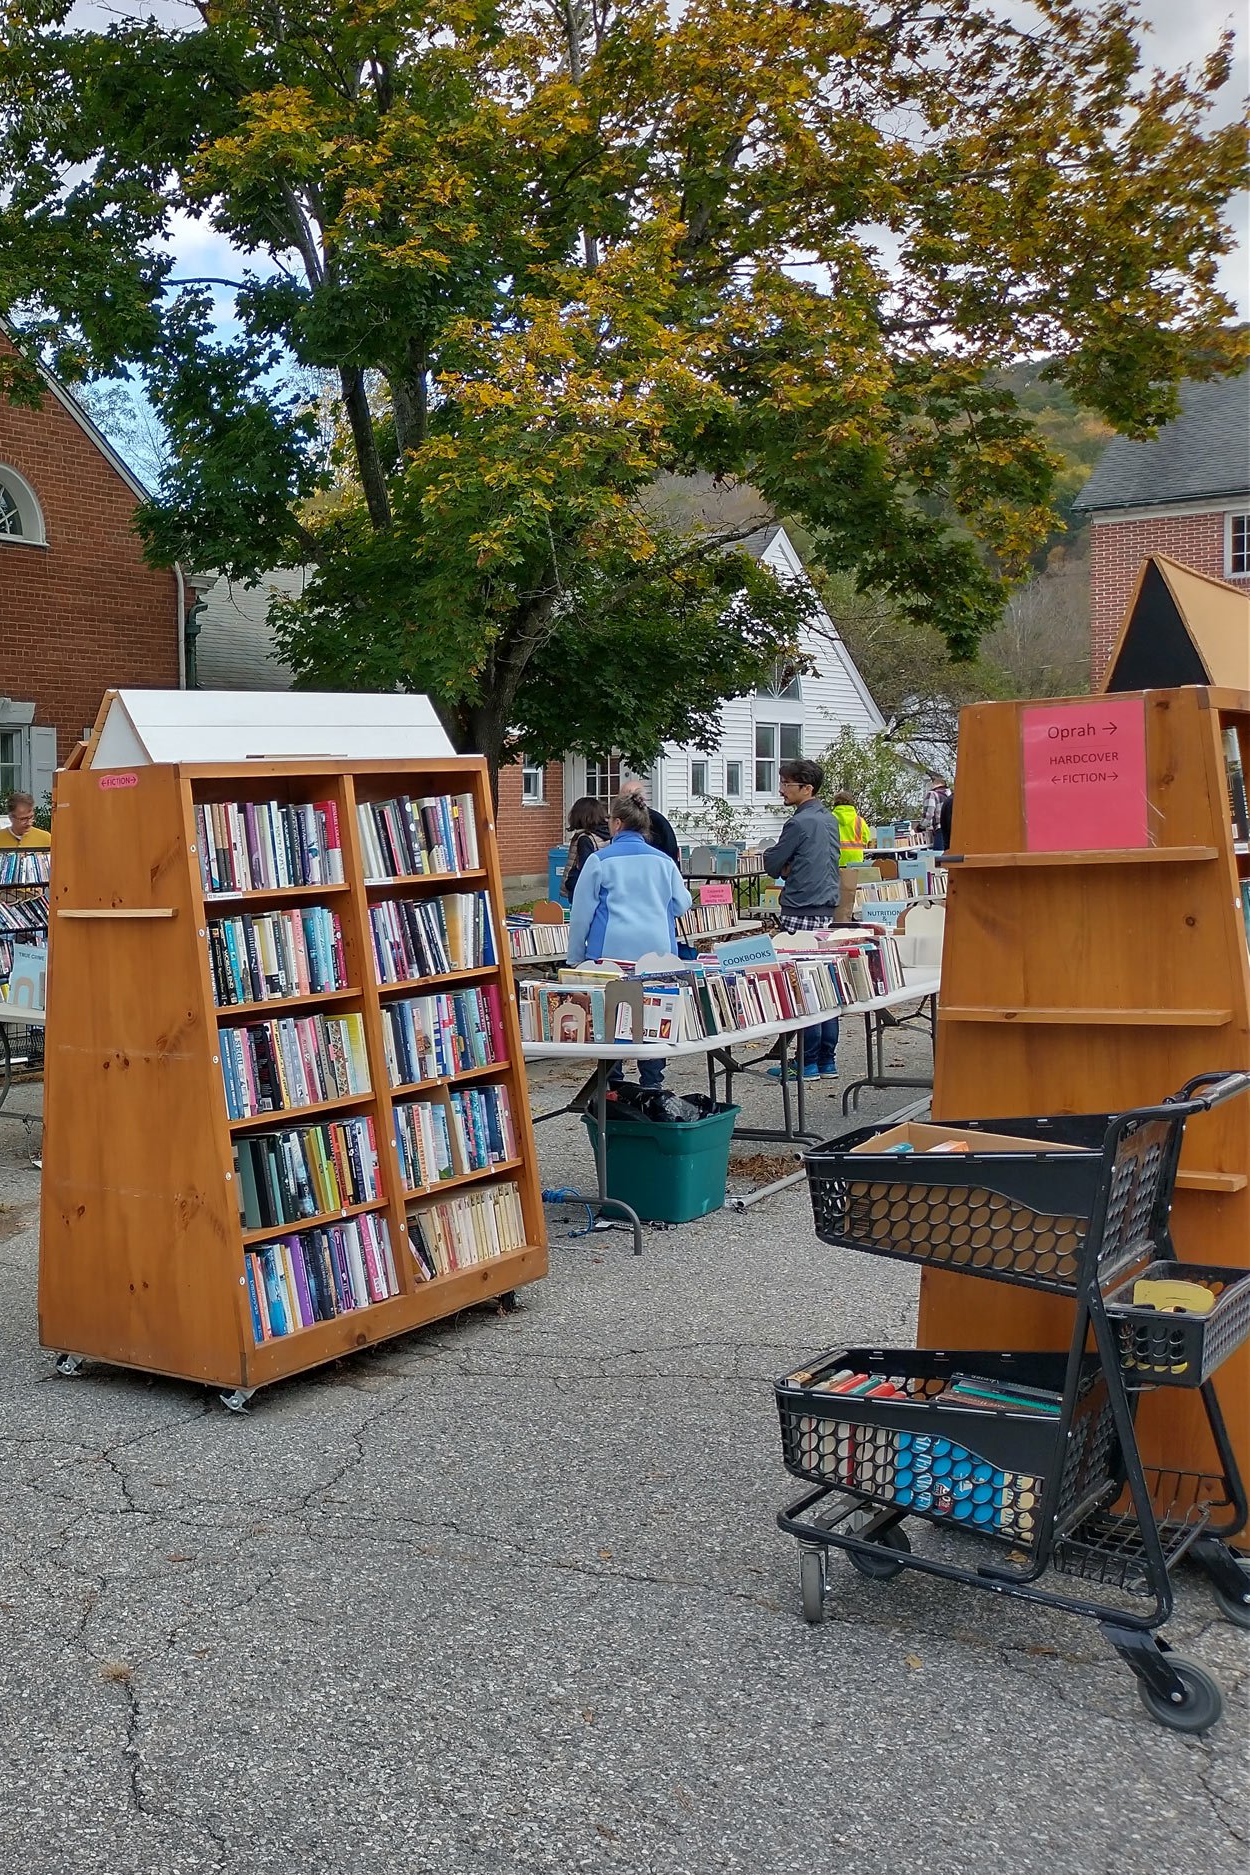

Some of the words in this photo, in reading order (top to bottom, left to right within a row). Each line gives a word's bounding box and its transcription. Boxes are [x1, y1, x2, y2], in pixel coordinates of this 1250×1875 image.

[1047, 722, 1096, 741] Oprah
[1049, 751, 1119, 766] HARDCOVER
[107, 777, 130, 786] FICTION
[1062, 772, 1107, 784] FICTION
[723, 949, 772, 967] COOKBOOKS
[234, 1040, 243, 1064] SEGU
